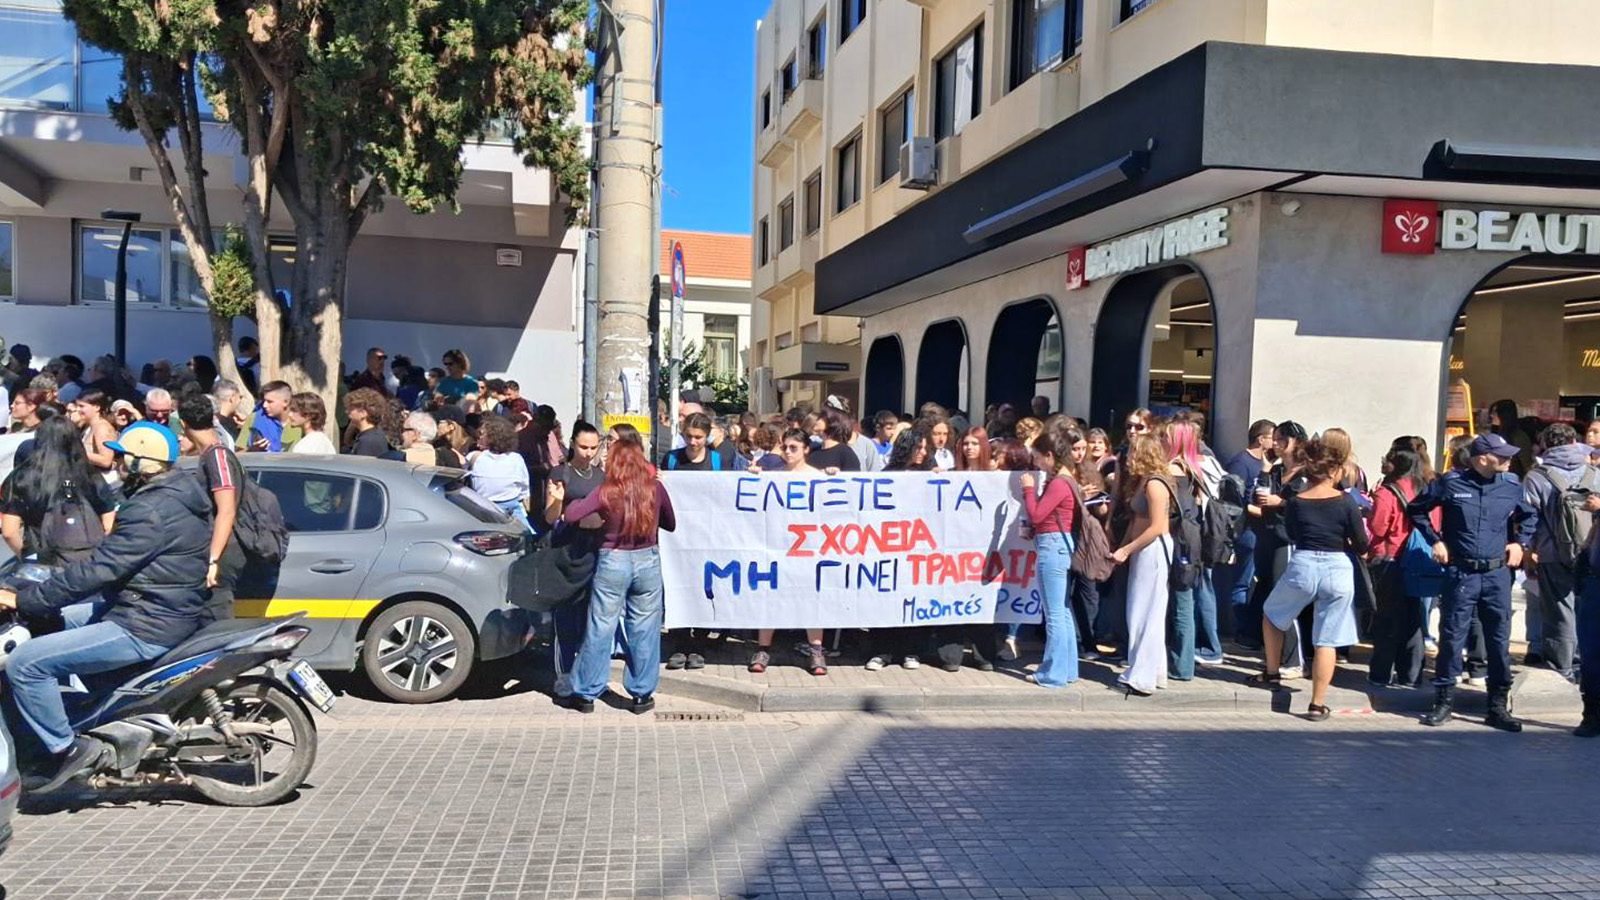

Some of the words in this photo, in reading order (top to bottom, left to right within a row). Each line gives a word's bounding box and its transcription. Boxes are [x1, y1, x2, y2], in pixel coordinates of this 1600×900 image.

[1084, 228, 1164, 281] BEAUTY
[1162, 207, 1229, 260] FREE
[735, 477, 896, 513] ΕΛΕΓΞΤΕ
[926, 479, 983, 512] ΤΑ
[786, 518, 938, 557] ΣΧΟΛΕΙΑ
[704, 560, 778, 602] ΜΗ
[816, 557, 898, 593] ΓΙΝΕΙ
[903, 594, 983, 624] Μαθητές
